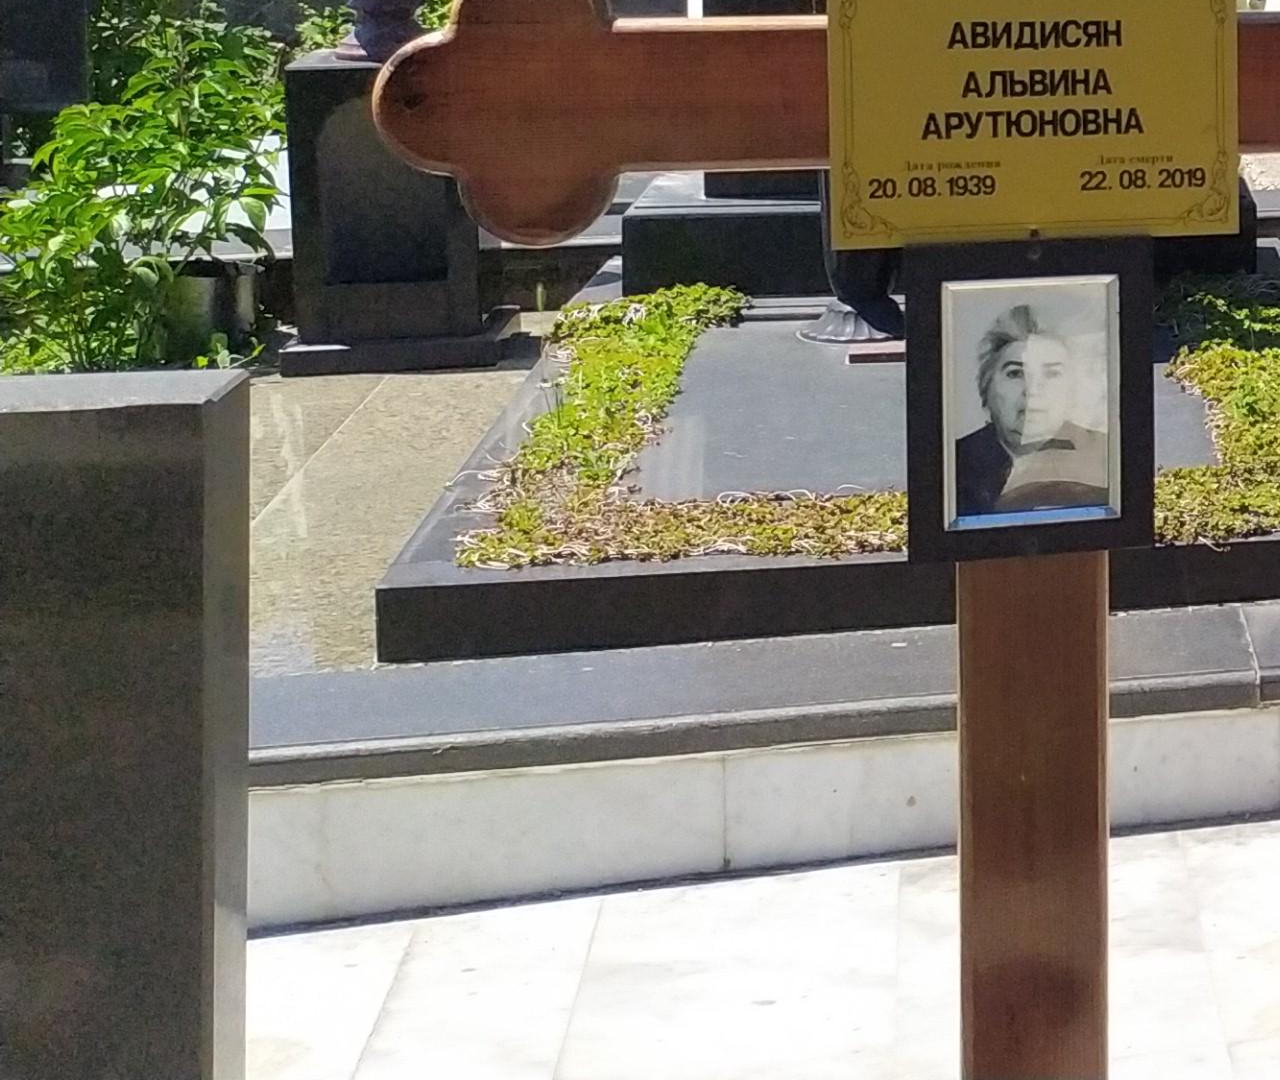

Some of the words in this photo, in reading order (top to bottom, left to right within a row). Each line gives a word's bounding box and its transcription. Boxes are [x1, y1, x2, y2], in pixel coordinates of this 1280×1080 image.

[947, 19, 1123, 51] АВИДИСЯН
[961, 67, 1113, 99] АЛЬВИНА
[921, 106, 1145, 141] АРУТЮНОВНА
